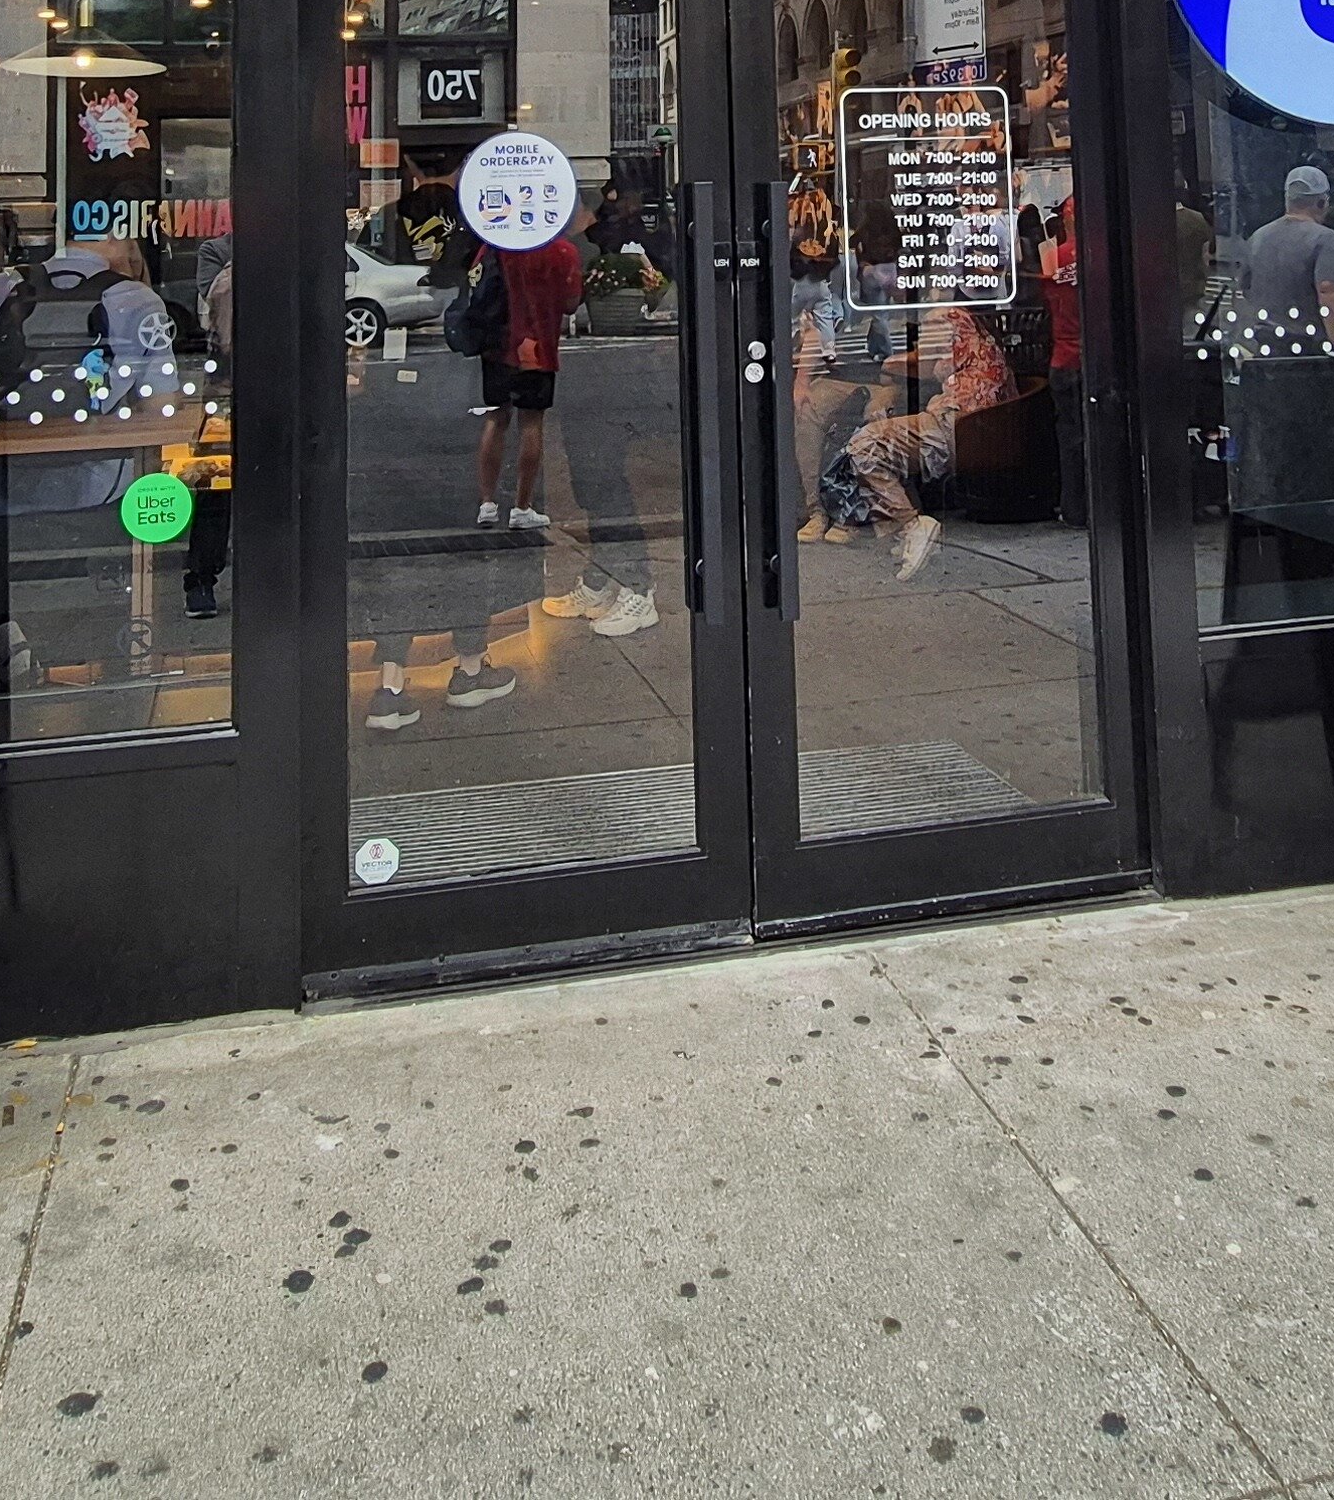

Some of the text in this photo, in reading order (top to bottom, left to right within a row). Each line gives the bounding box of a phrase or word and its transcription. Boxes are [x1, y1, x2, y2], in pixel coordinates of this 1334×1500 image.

[858, 112, 992, 129] OPENING HOURS
[495, 144, 539, 154] MOBILE
[480, 156, 554, 167] ORDER&PAY
[888, 151, 997, 166] MON 7:00-21:00
[894, 171, 997, 186] TUE 7:00-21:00
[890, 193, 997, 206] WED 7:00-21:00
[894, 214, 923, 228] THU
[902, 234, 998, 247] FRI 7:0-21:00
[714, 258, 730, 267] USH
[740, 258, 760, 267] PUSH
[898, 254, 999, 268] SAT 7:00-21:00
[897, 275, 999, 289] SUN 7:00-21:00
[137, 495, 176, 510] Uber
[137, 510, 176, 525] Eats
